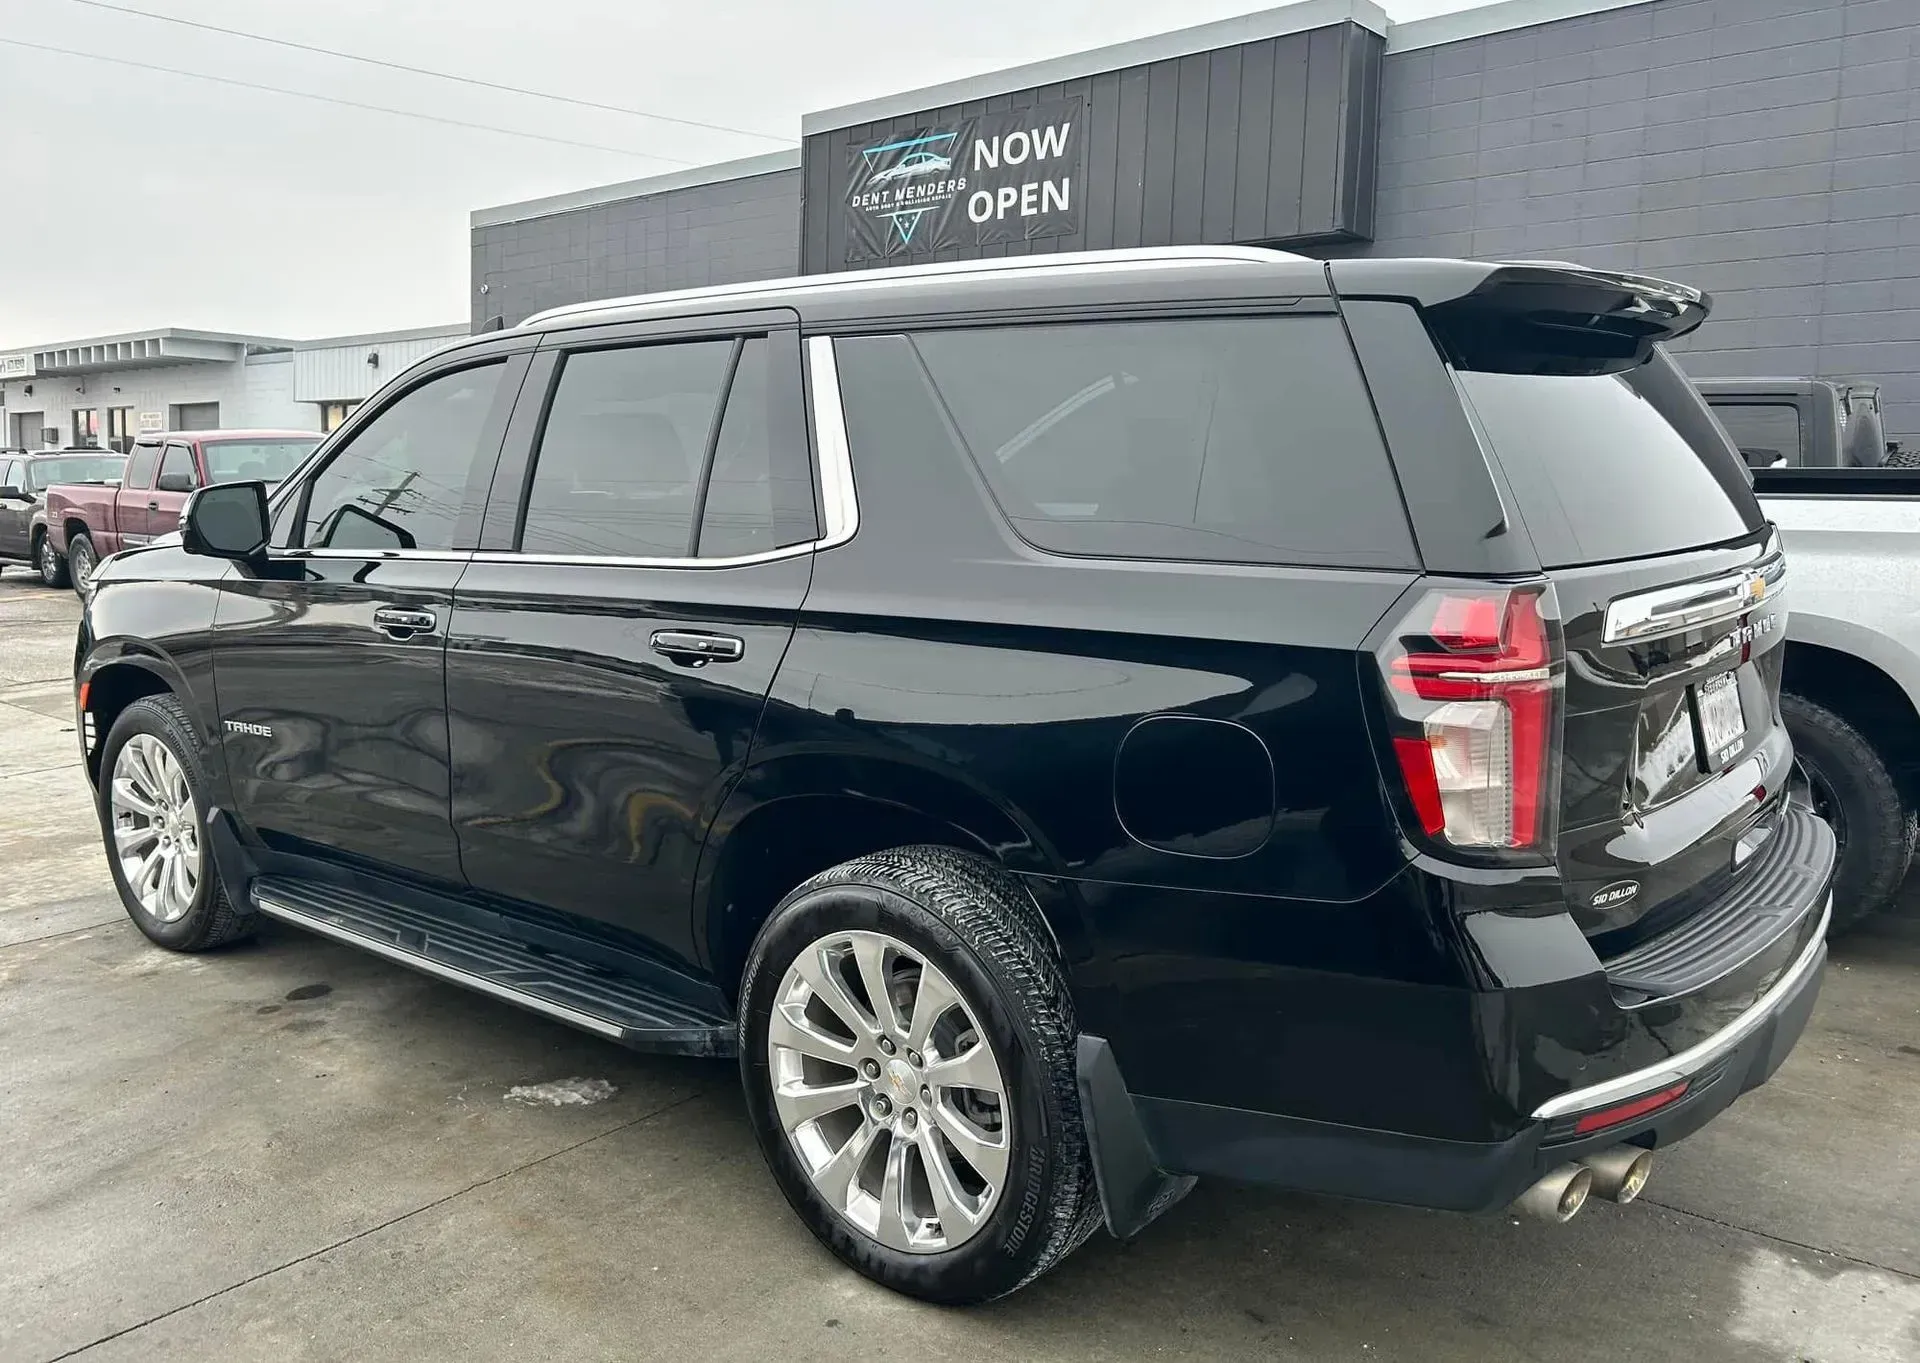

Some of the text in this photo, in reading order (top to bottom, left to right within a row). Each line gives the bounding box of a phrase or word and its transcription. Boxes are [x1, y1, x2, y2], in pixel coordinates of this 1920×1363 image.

[973, 122, 1070, 171] NOW
[851, 177, 967, 208] DENT MENDERS
[967, 177, 1070, 224] OPEN
[223, 720, 273, 737] TAHOE
[1593, 885, 1638, 905] SID DILLON
[1002, 1144, 1047, 1258] BRIDGESTONE
